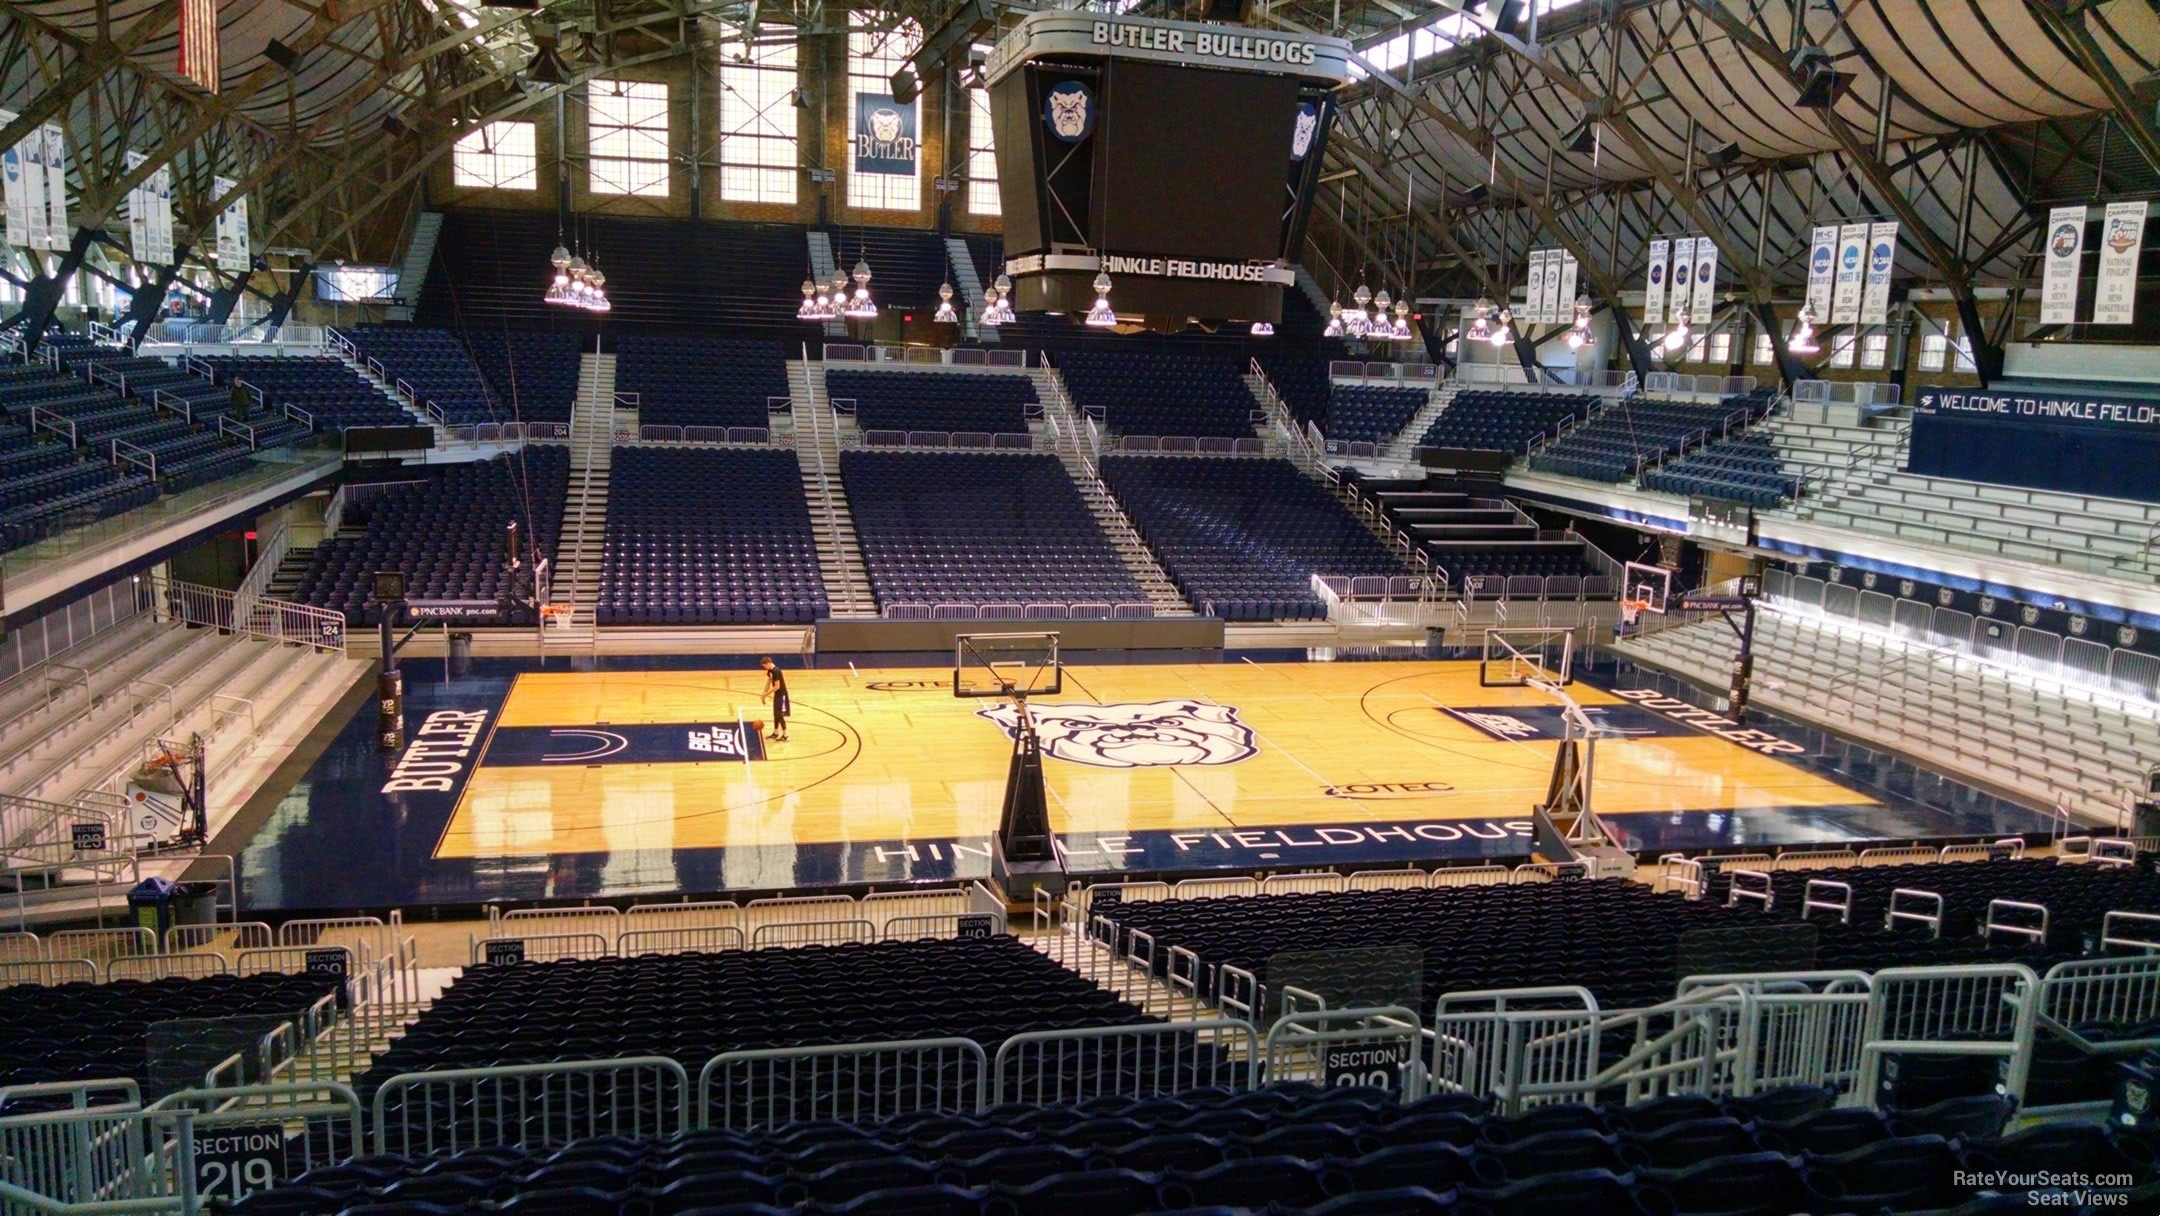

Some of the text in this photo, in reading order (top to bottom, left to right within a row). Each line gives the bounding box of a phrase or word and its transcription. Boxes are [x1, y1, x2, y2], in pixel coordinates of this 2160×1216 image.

[1092, 21, 1316, 65] BUTLER BULLDOGS
[858, 134, 914, 161] BUTLER
[2051, 216, 2084, 224] CHAMPIONS
[2107, 209, 2144, 217] CHAMPIONS
[1103, 255, 1264, 281] HINKLE FIELDHOUSE
[1939, 394, 2010, 413] WELCOME
[2014, 399, 2036, 415] TO
[2038, 401, 2096, 419] HINKLE
[466, 608, 497, 616] pnc.com
[322, 626, 338, 635] 124
[1610, 689, 1805, 754] BUTLER
[380, 709, 489, 793] BUTLER
[688, 731, 712, 752] BIG
[711, 726, 735, 755] EAST
[77, 834, 102, 848] 123
[874, 820, 1534, 863] HINLE FIELDHOUS
[308, 954, 345, 962] SECTION
[488, 944, 523, 952] SECTION
[1329, 1049, 1397, 1069] SECTION
[193, 1133, 280, 1156] SECTION
[200, 1158, 274, 1200] 219
